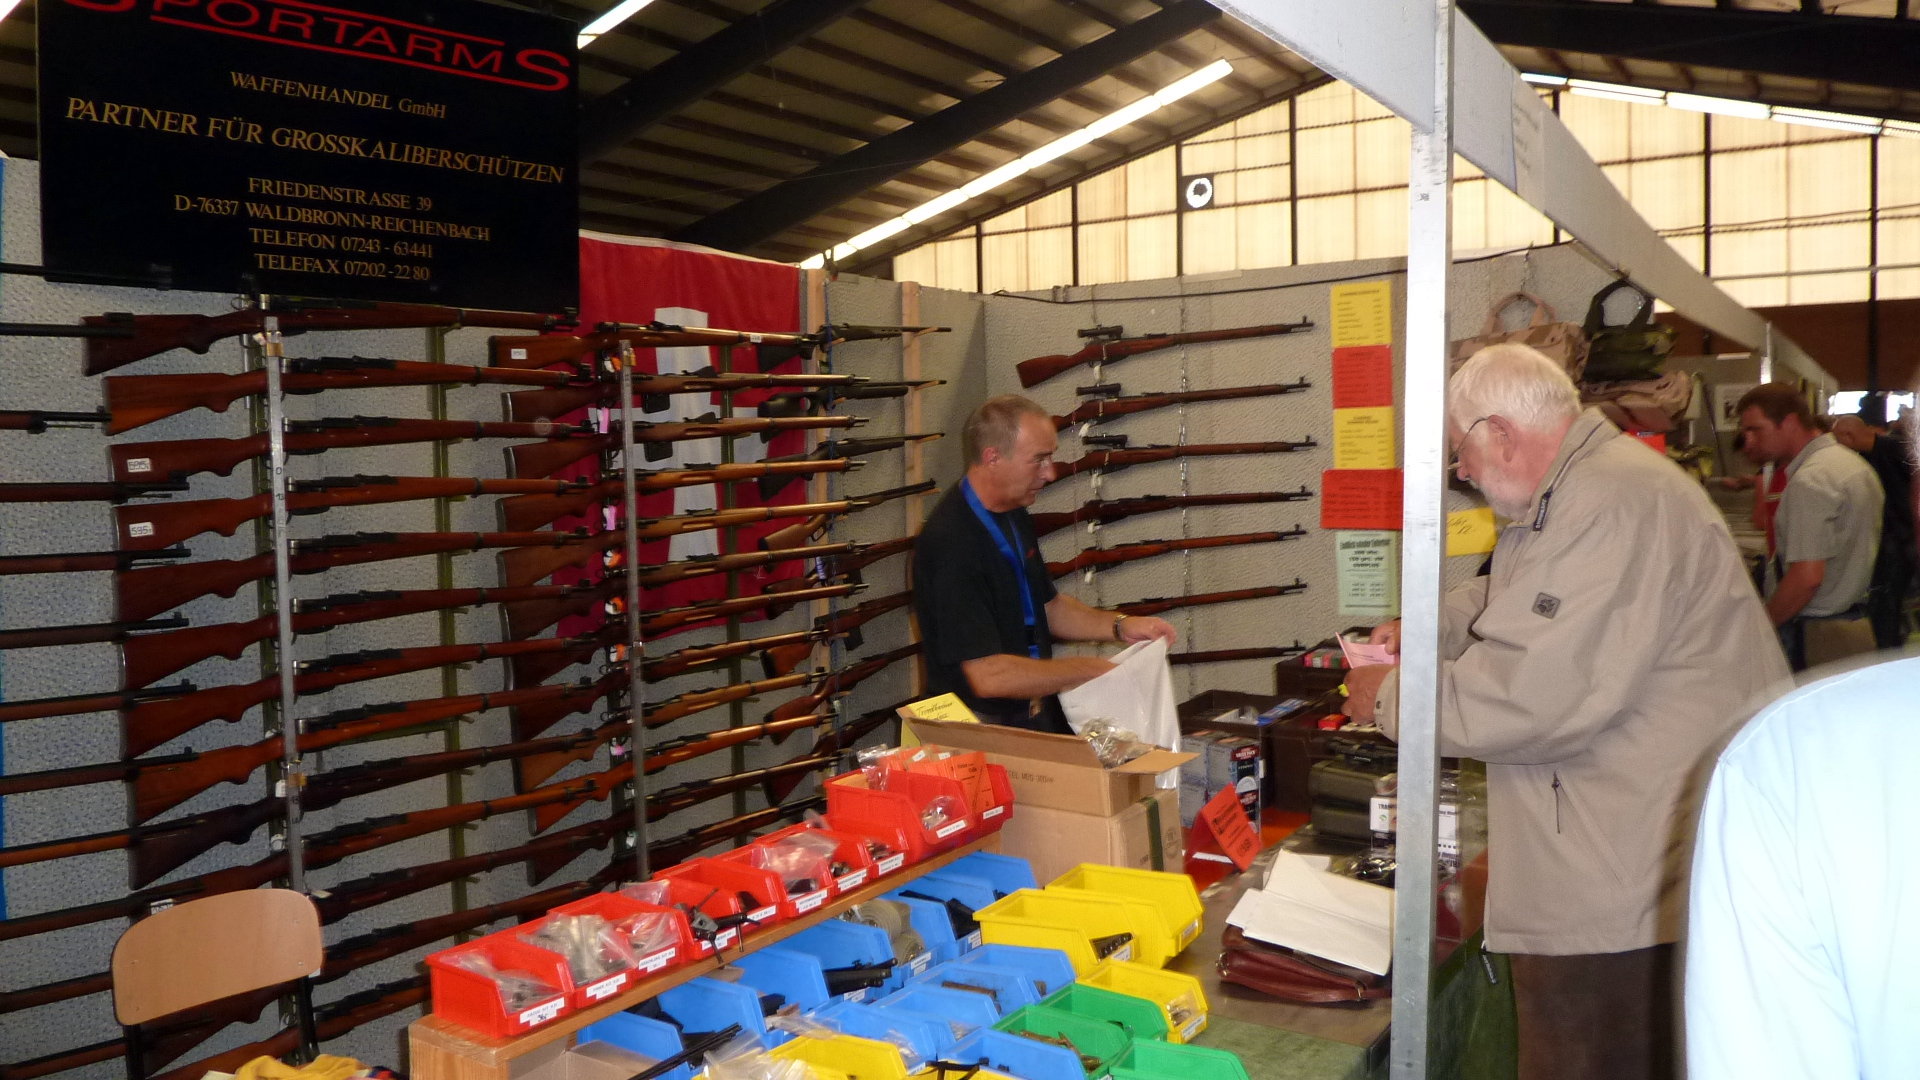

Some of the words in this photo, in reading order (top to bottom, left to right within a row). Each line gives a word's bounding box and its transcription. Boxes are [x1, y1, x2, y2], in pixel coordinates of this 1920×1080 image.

[230, 71, 392, 111] WAFFENHANDEL
[398, 98, 447, 120] GmbH
[65, 97, 199, 136] PARTNER
[206, 116, 264, 146] FÜR
[248, 177, 411, 211] FRIEDENSTRASSE
[416, 196, 433, 212] 39
[174, 194, 240, 217] D-76337
[245, 202, 491, 242] WALDBRONN-REICHENBACH
[249, 228, 337, 250] TELEFON
[341, 236, 382, 253] 07243
[392, 241, 433, 259] 63441
[254, 253, 341, 275] TELEFAX
